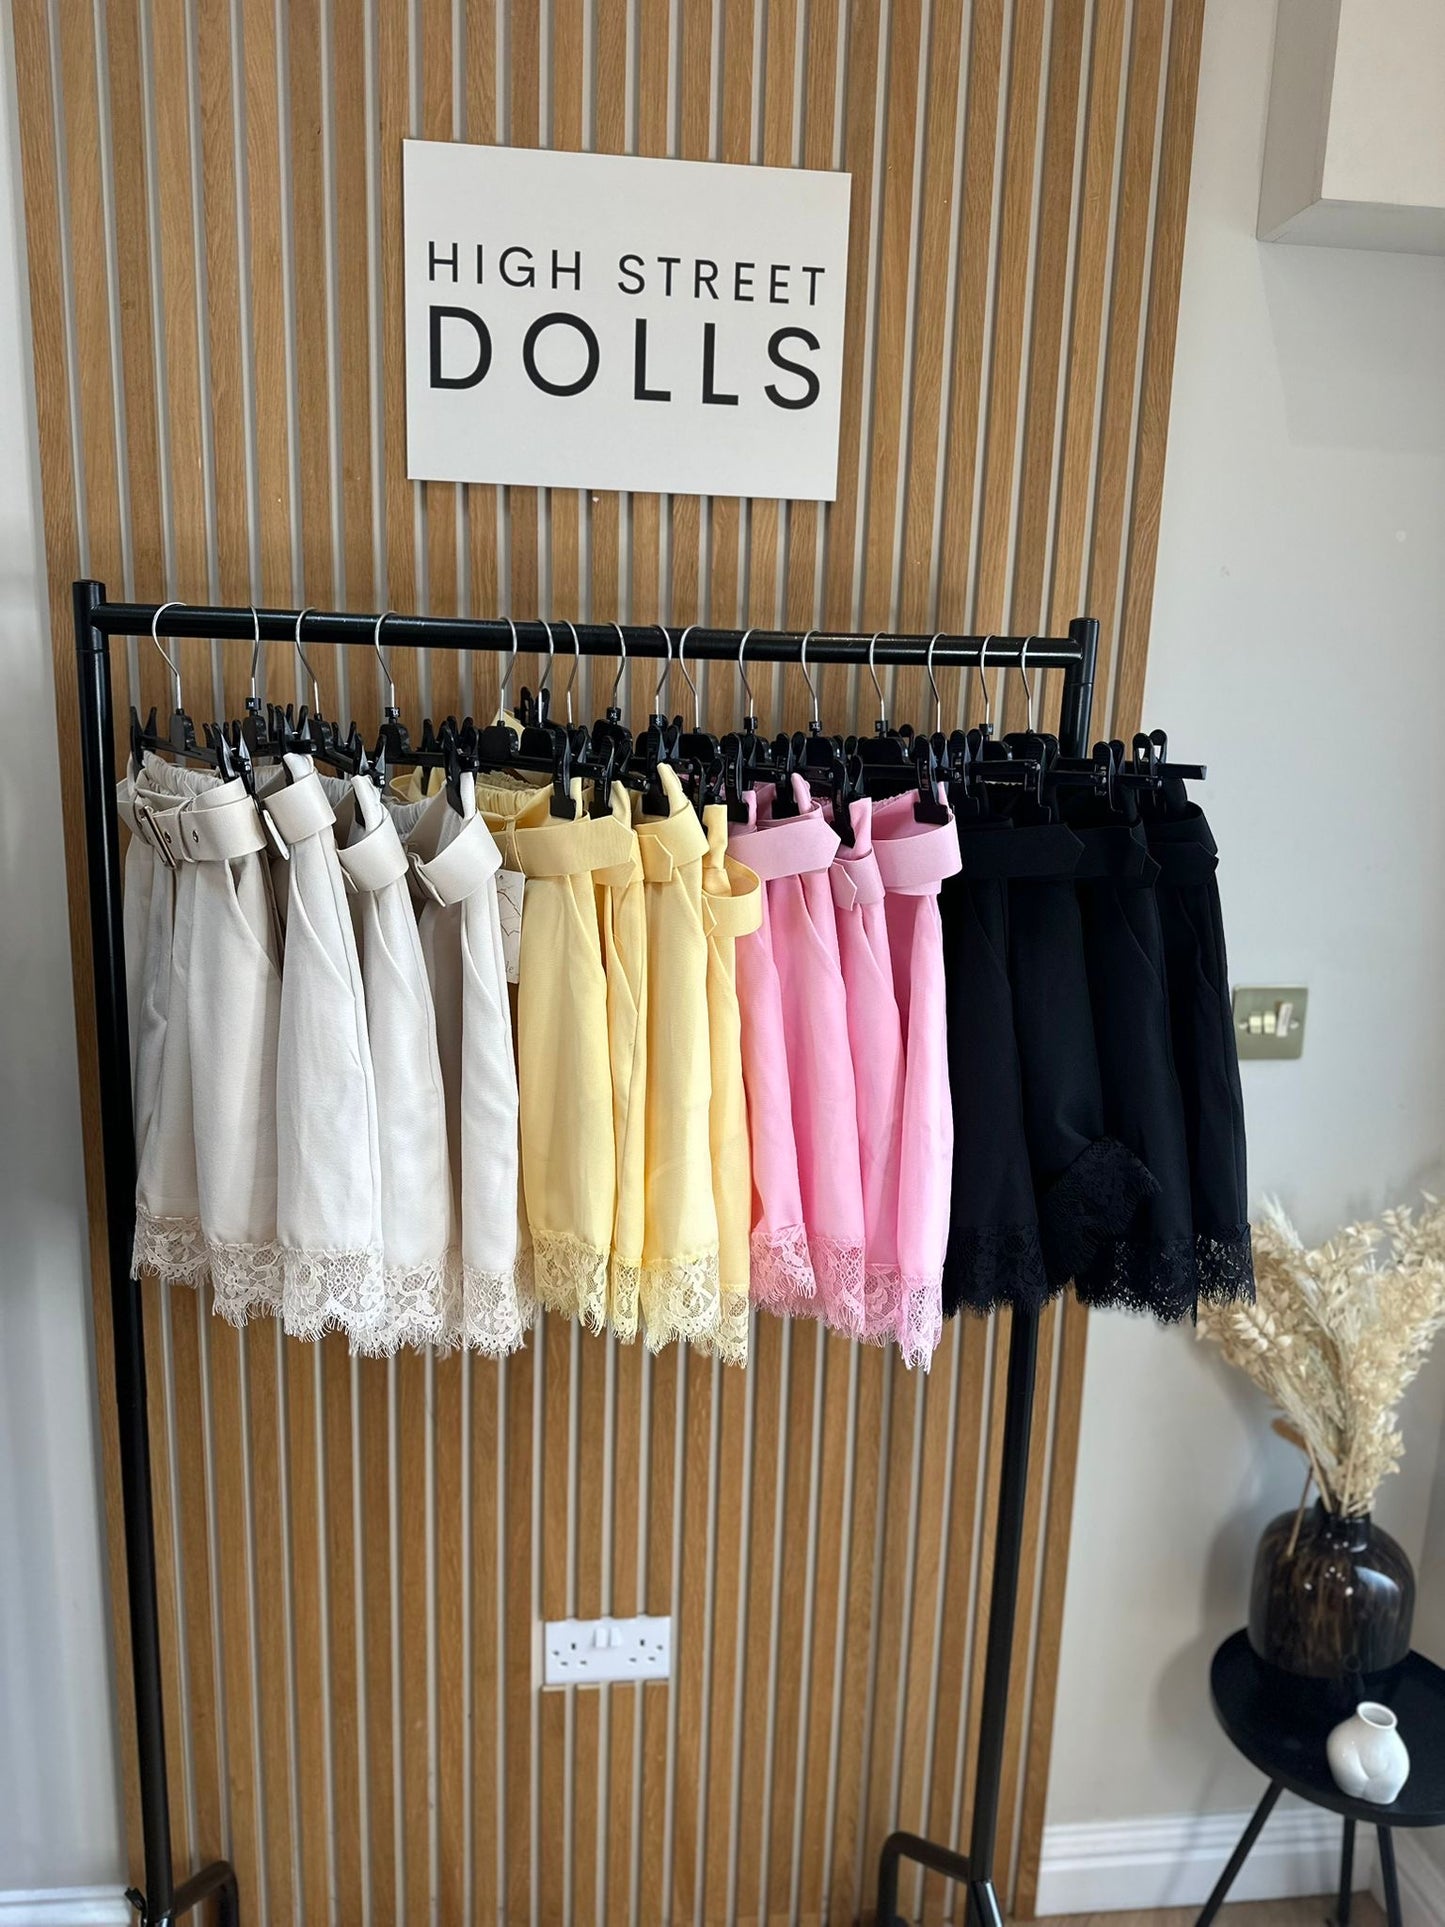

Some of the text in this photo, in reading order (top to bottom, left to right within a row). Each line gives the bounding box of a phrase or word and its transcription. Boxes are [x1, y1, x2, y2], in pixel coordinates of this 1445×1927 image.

[428, 240, 826, 306] HIGH STREET
[429, 305, 821, 411] DOLLS
